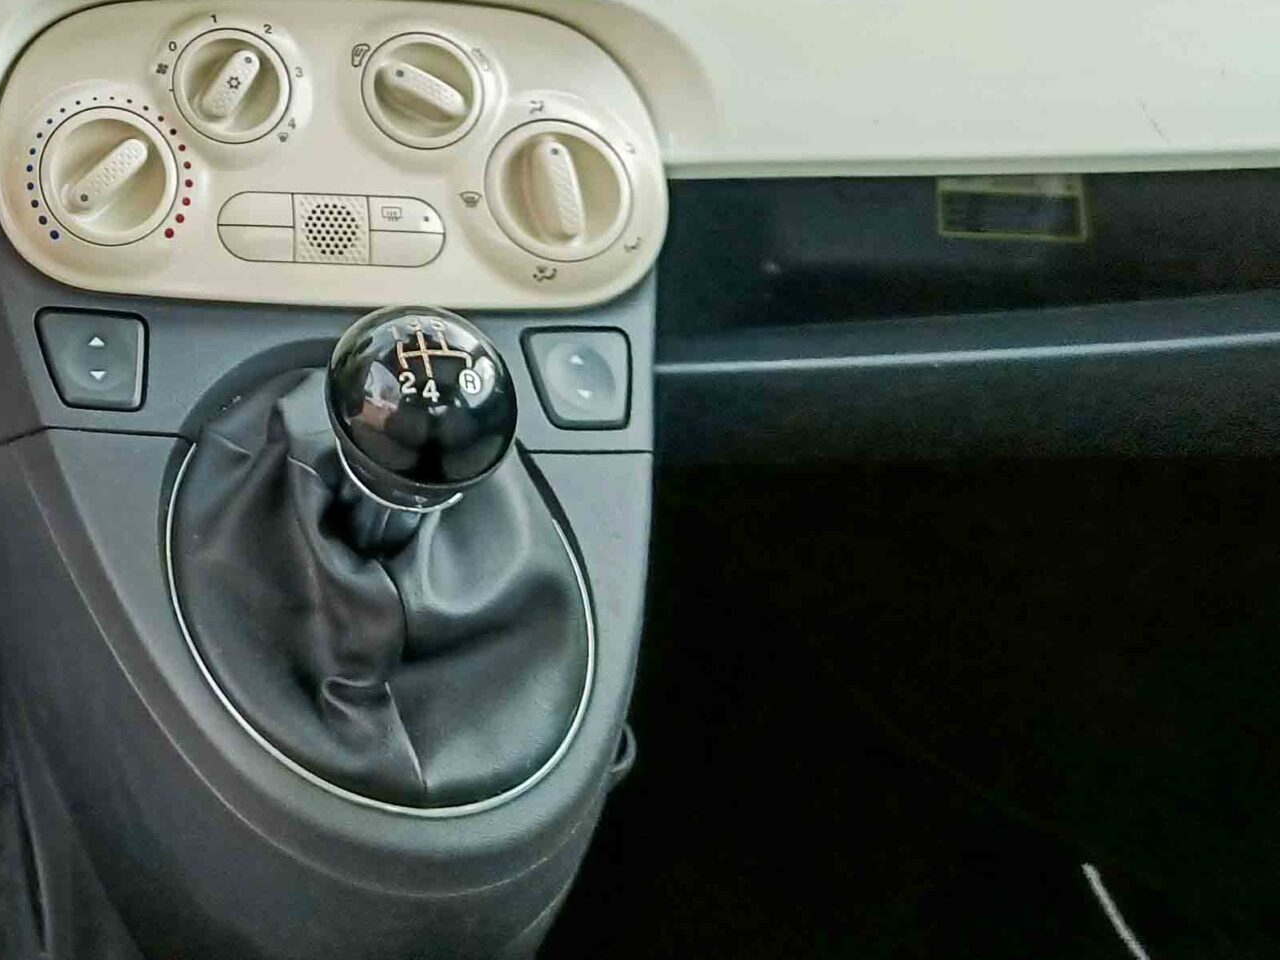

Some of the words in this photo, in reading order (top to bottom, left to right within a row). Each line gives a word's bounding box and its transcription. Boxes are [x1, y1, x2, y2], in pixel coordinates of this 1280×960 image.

[210, 13, 218, 23] 1
[263, 24, 273, 34] 2
[168, 41, 177, 51] 0
[294, 66, 304, 78] 3
[288, 118, 297, 129] 4
[399, 371, 417, 394] 2
[463, 372, 477, 391] R
[422, 379, 440, 403] 4
